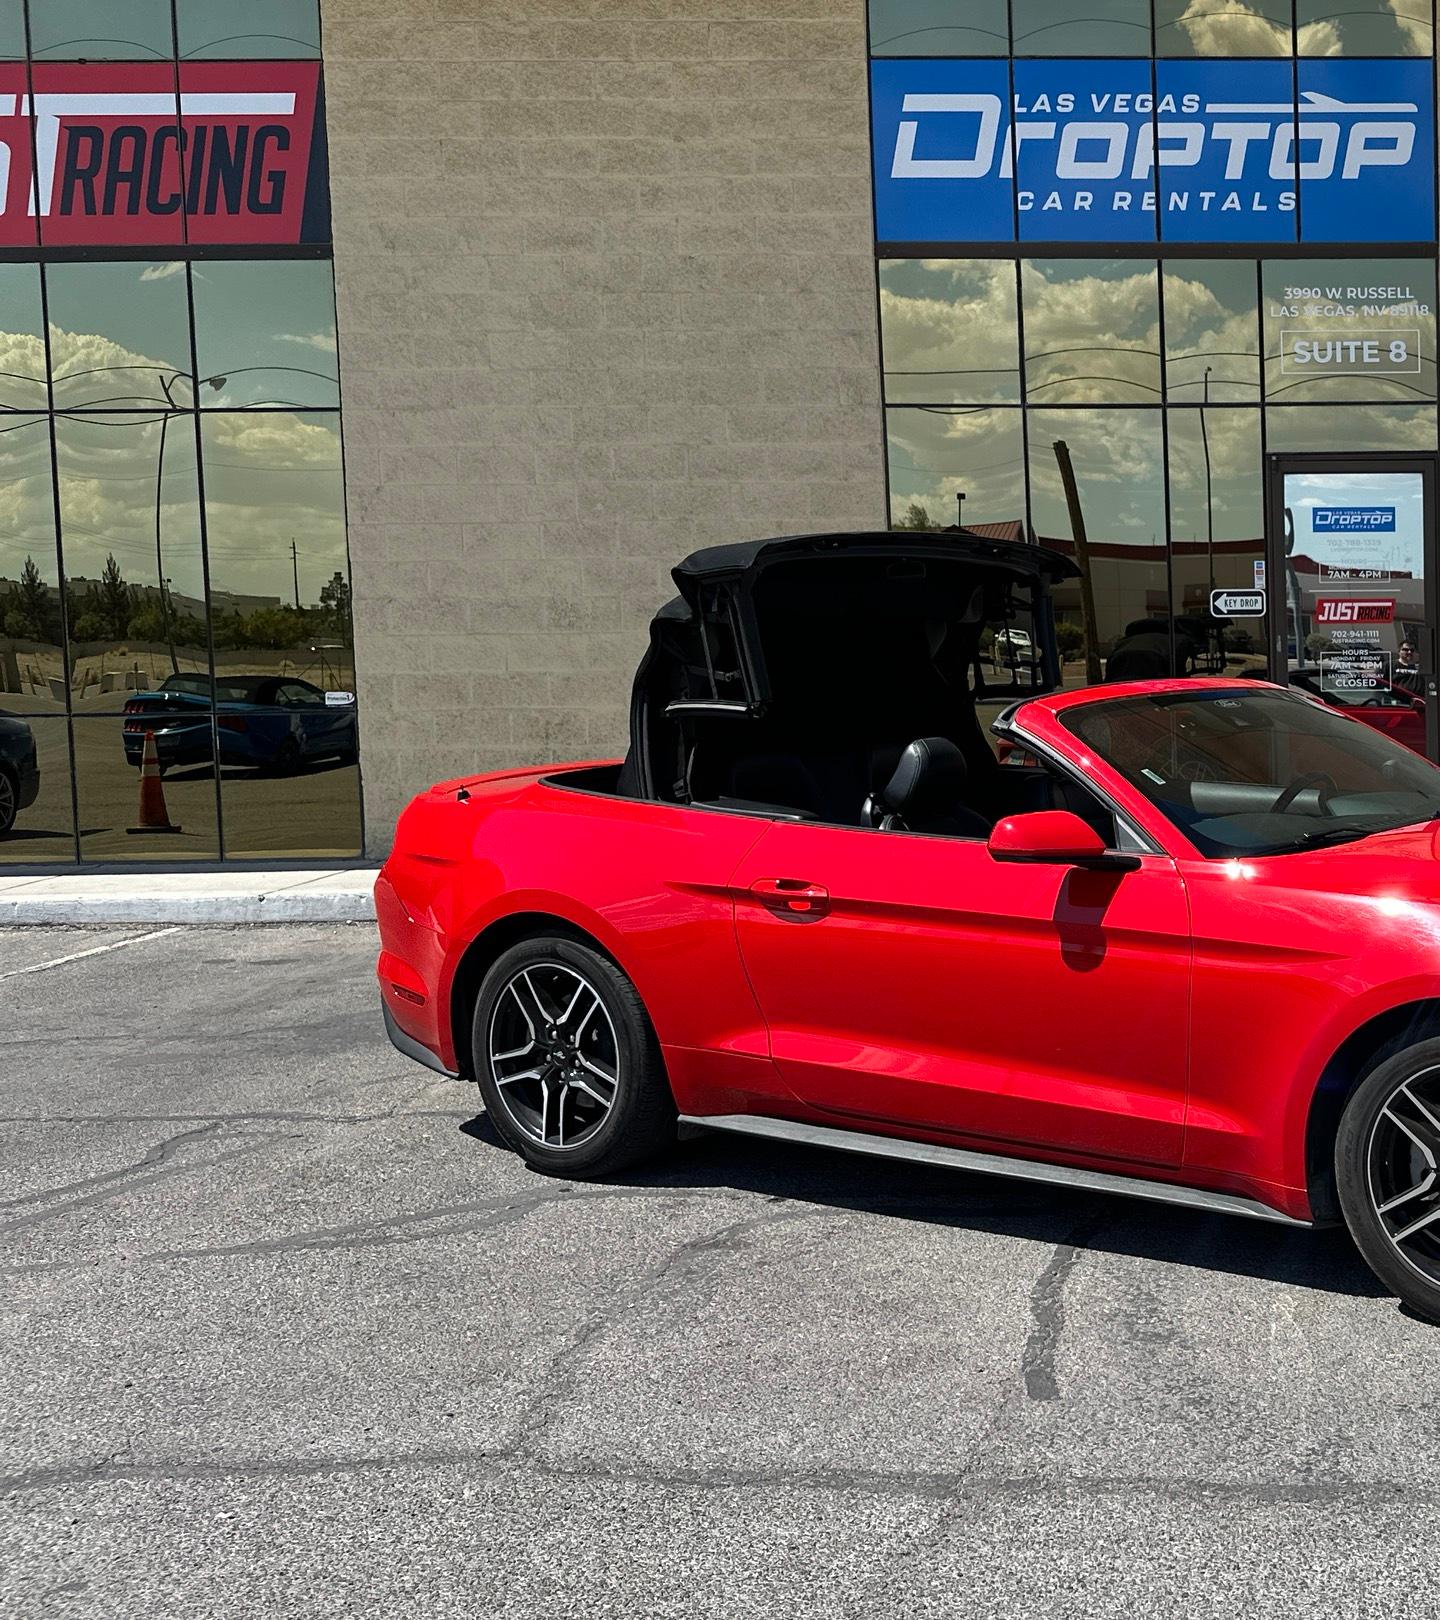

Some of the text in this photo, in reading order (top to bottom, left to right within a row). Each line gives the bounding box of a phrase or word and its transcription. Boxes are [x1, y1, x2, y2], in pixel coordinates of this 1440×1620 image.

[1014, 93, 1201, 113] LAS VEGAS
[59, 125, 290, 215] RACING
[1017, 191, 1297, 211] CAR RENTALS
[1284, 287, 1322, 299] 3990
[1347, 287, 1414, 299] RUSSELL
[1270, 305, 1299, 317] LAS
[1363, 305, 1386, 316] NV
[1390, 304, 1429, 316] 89118
[1294, 340, 1408, 363] SUITE 8
[1328, 570, 1350, 579] 7AM
[1358, 570, 1382, 579] 4PM
[1224, 598, 1259, 608] KEY DROP
[1357, 606, 1390, 620] RACING
[1331, 630, 1379, 638] 702-941-1111
[1330, 661, 1351, 669] 7AM
[1360, 661, 1382, 669] 4PM
[1335, 679, 1377, 687] CLOSED
